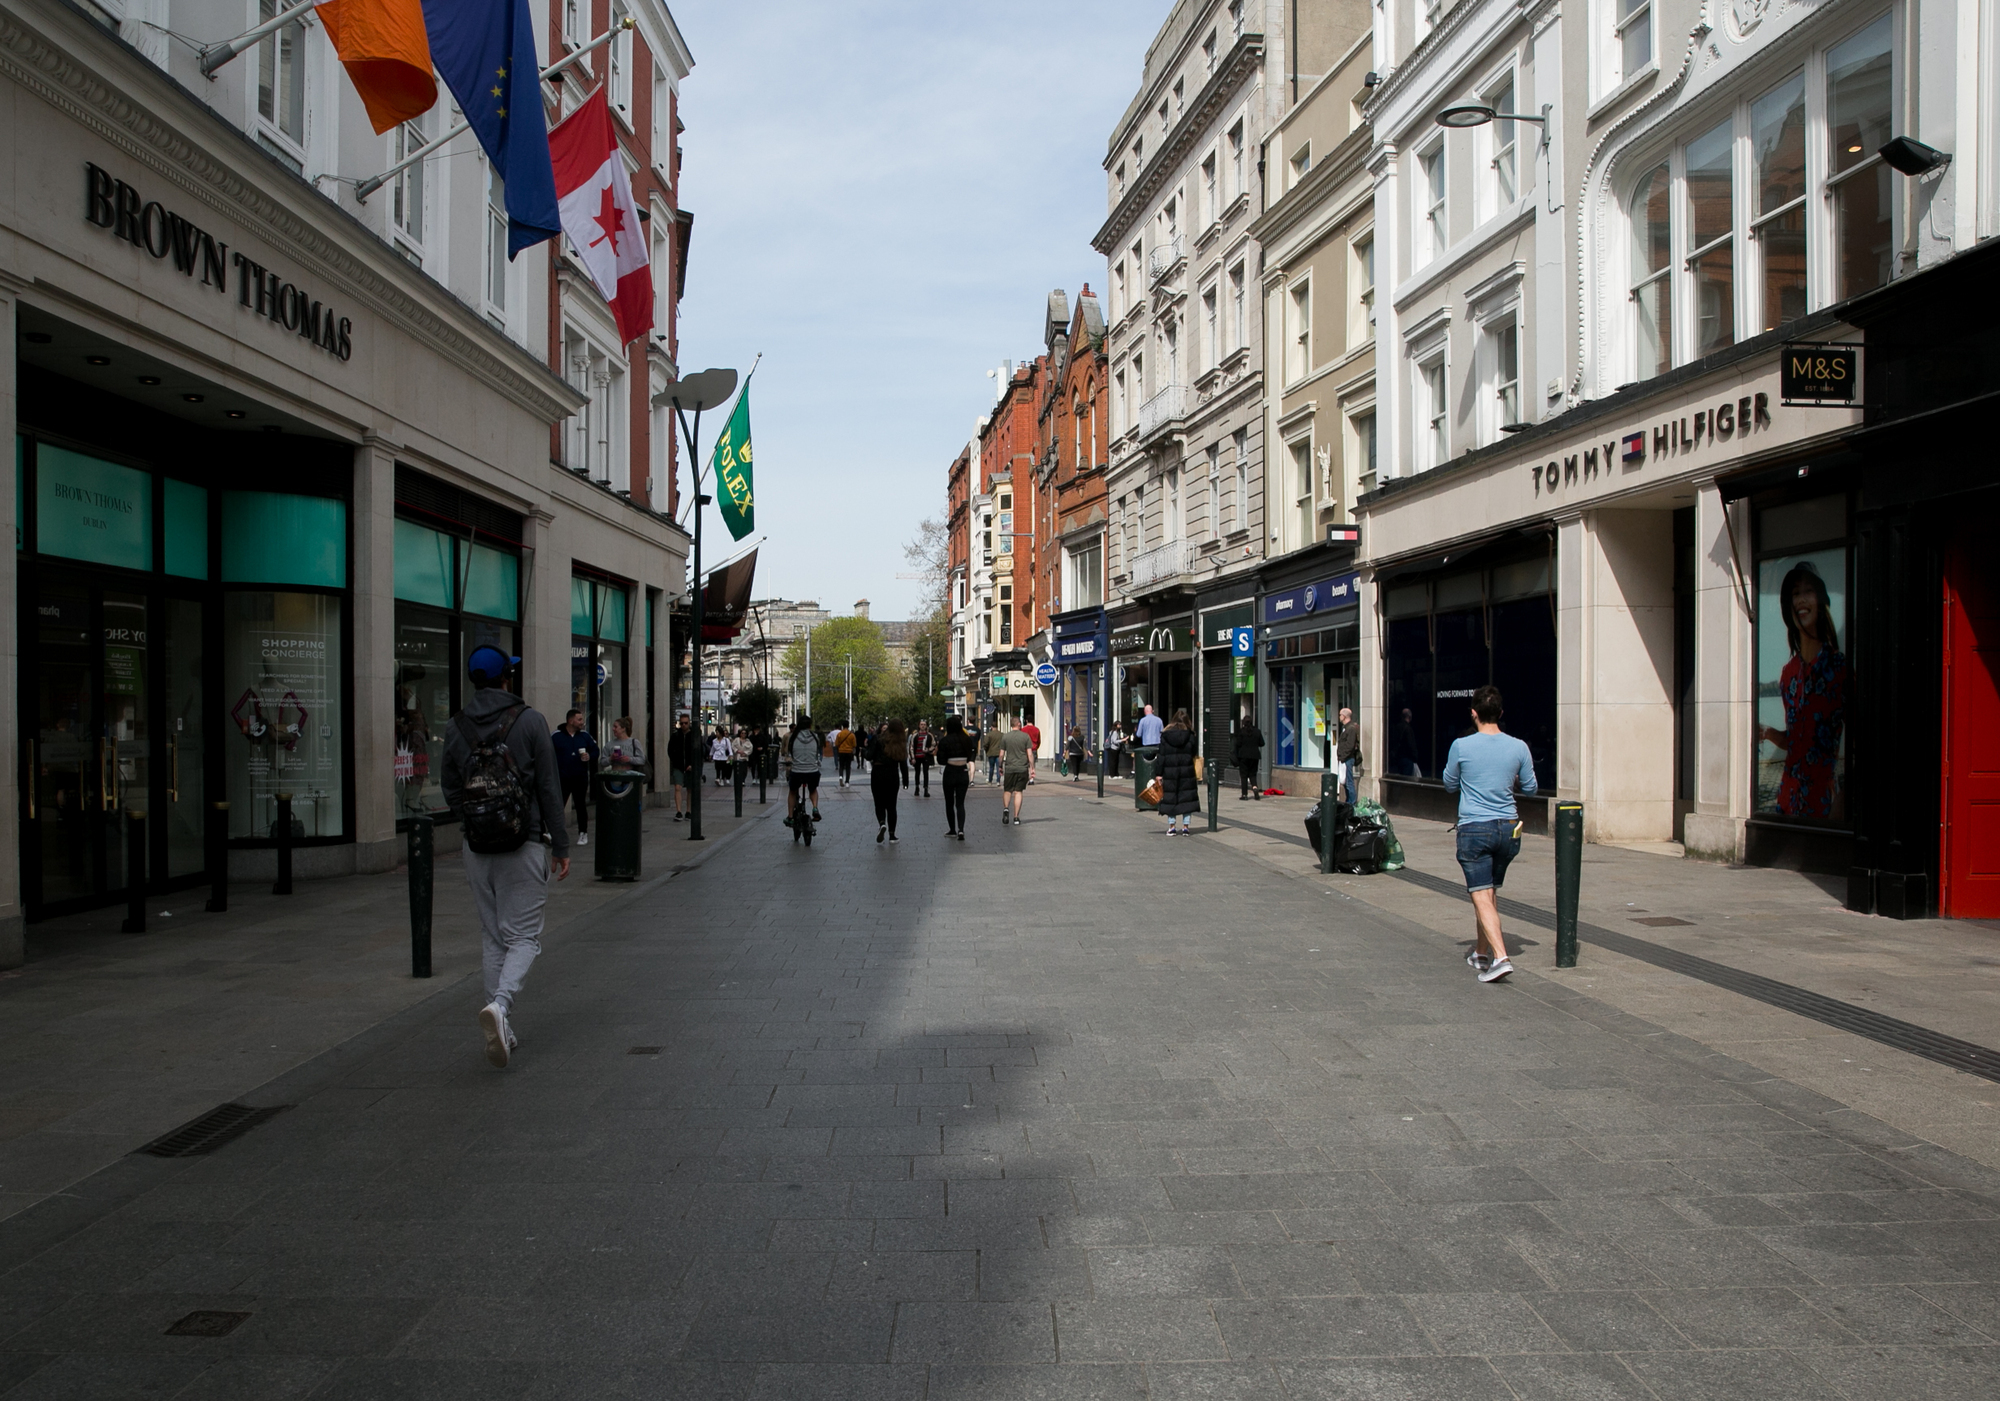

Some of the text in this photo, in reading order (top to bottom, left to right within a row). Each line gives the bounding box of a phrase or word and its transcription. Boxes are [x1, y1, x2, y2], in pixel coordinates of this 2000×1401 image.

[86, 161, 352, 362] BROWN THOMAS
[1792, 357, 1846, 380] M&S
[1532, 392, 1771, 489] TOMMY HILFIGER
[55, 482, 133, 515] BROWN THOMAS
[82, 516, 108, 530] DUBLIN
[1275, 598, 1294, 613] pharmacy
[1332, 582, 1348, 598] beauty
[262, 639, 325, 649] SHOPPING
[1239, 632, 1250, 652] S
[262, 649, 325, 659] CONCIERGE
[1436, 690, 1451, 699] MOVING
[1451, 689, 1468, 698] FORWARD
